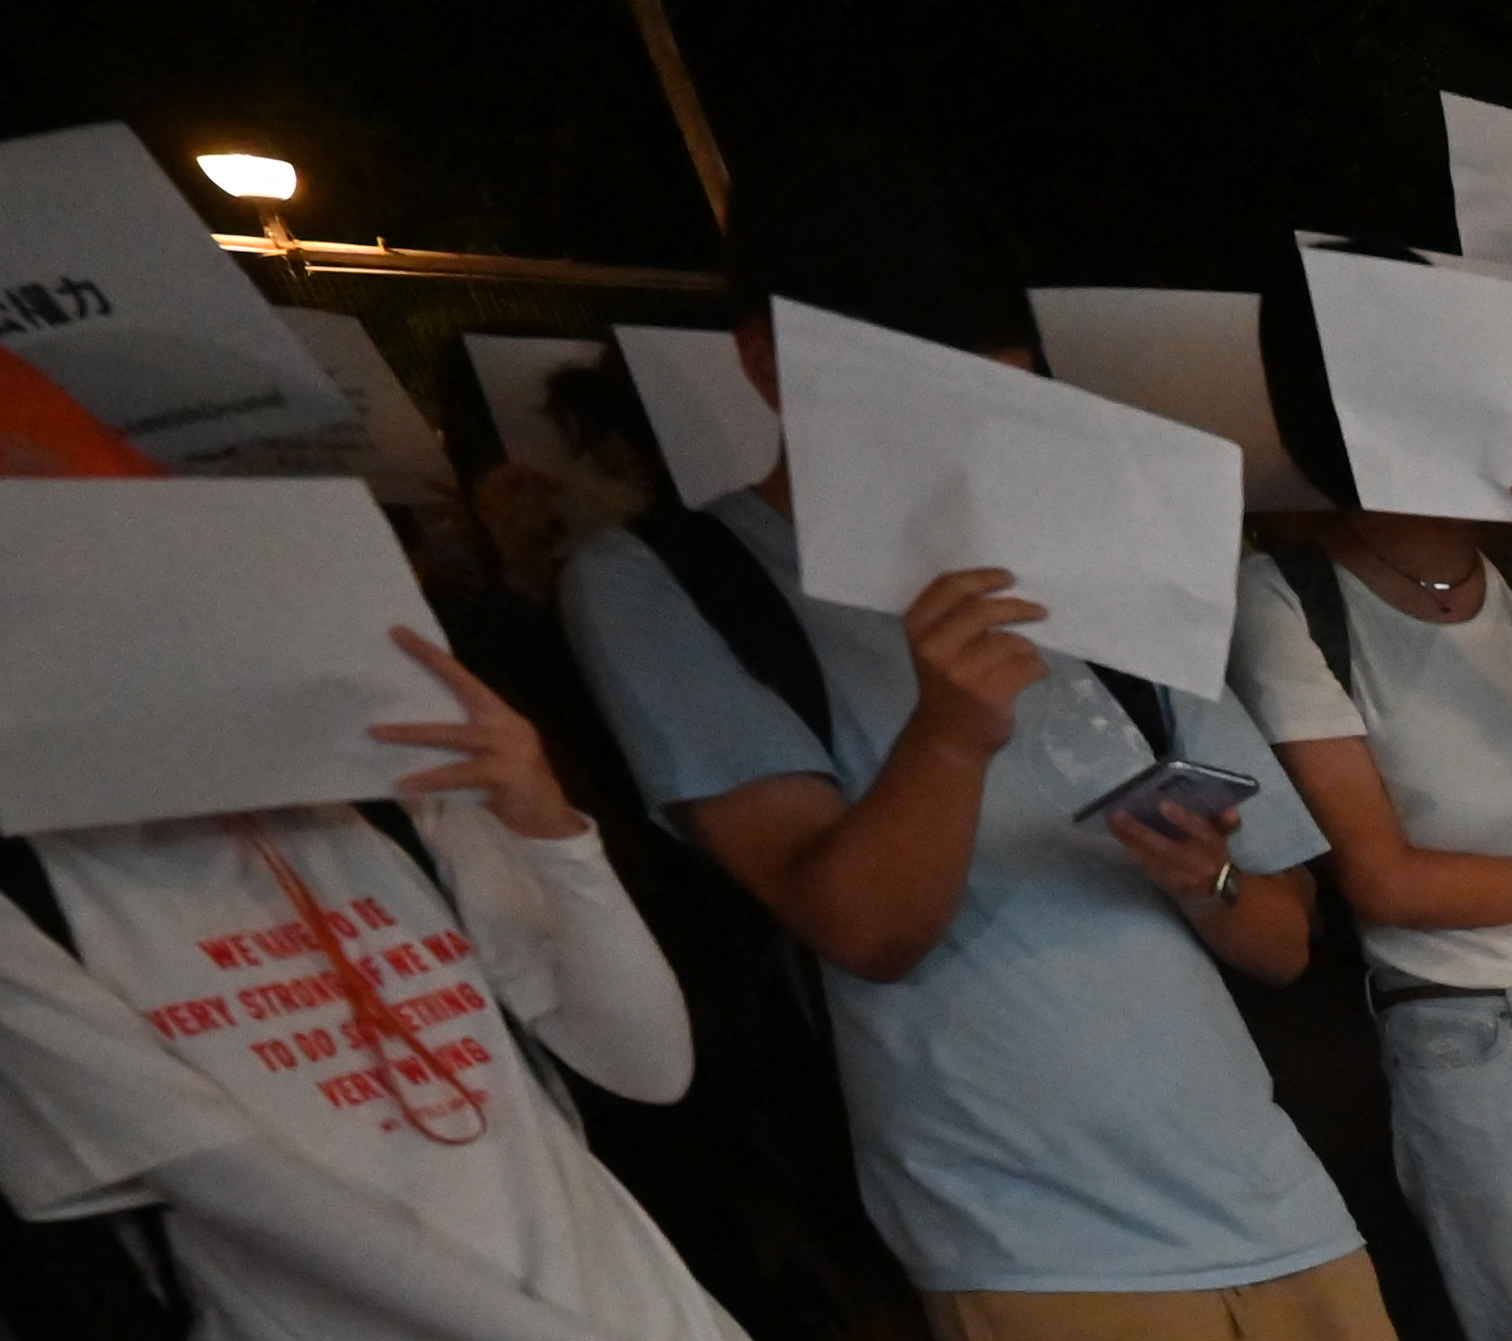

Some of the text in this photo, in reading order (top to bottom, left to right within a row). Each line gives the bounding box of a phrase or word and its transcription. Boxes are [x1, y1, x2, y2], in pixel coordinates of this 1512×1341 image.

[198, 934, 260, 971] WE
[147, 994, 236, 1041] VERY
[384, 941, 431, 978] WE
[251, 1038, 298, 1074] TO
[296, 1028, 338, 1063] DO
